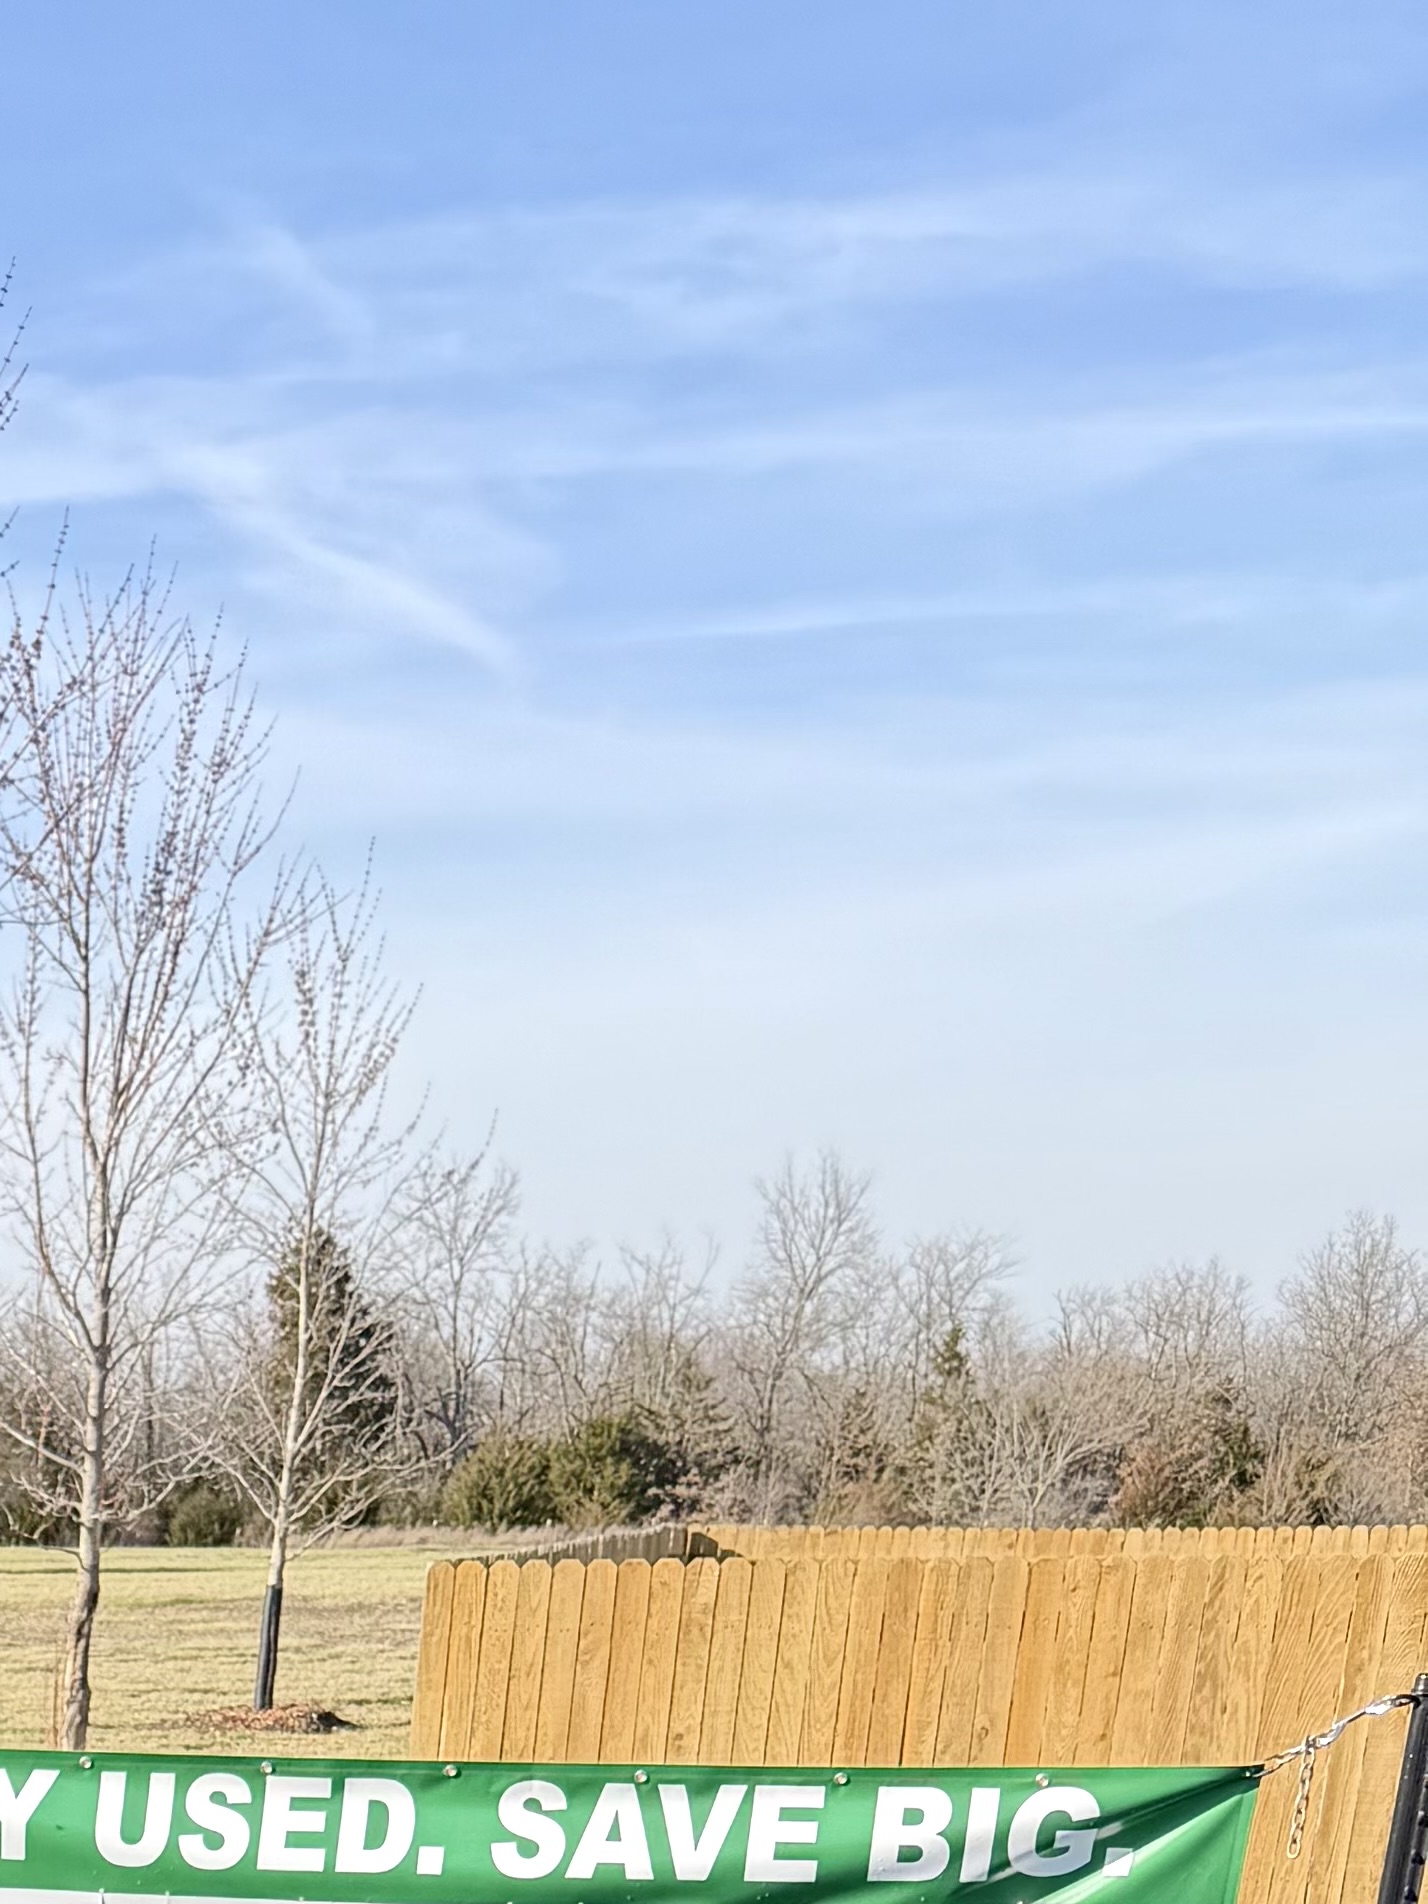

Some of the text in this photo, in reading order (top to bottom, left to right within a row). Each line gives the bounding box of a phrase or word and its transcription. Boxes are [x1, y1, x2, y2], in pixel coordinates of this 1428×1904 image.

[94, 1770, 445, 1876] USED.
[490, 1779, 826, 1882] SAVE
[866, 1785, 1134, 1883] BIG.
